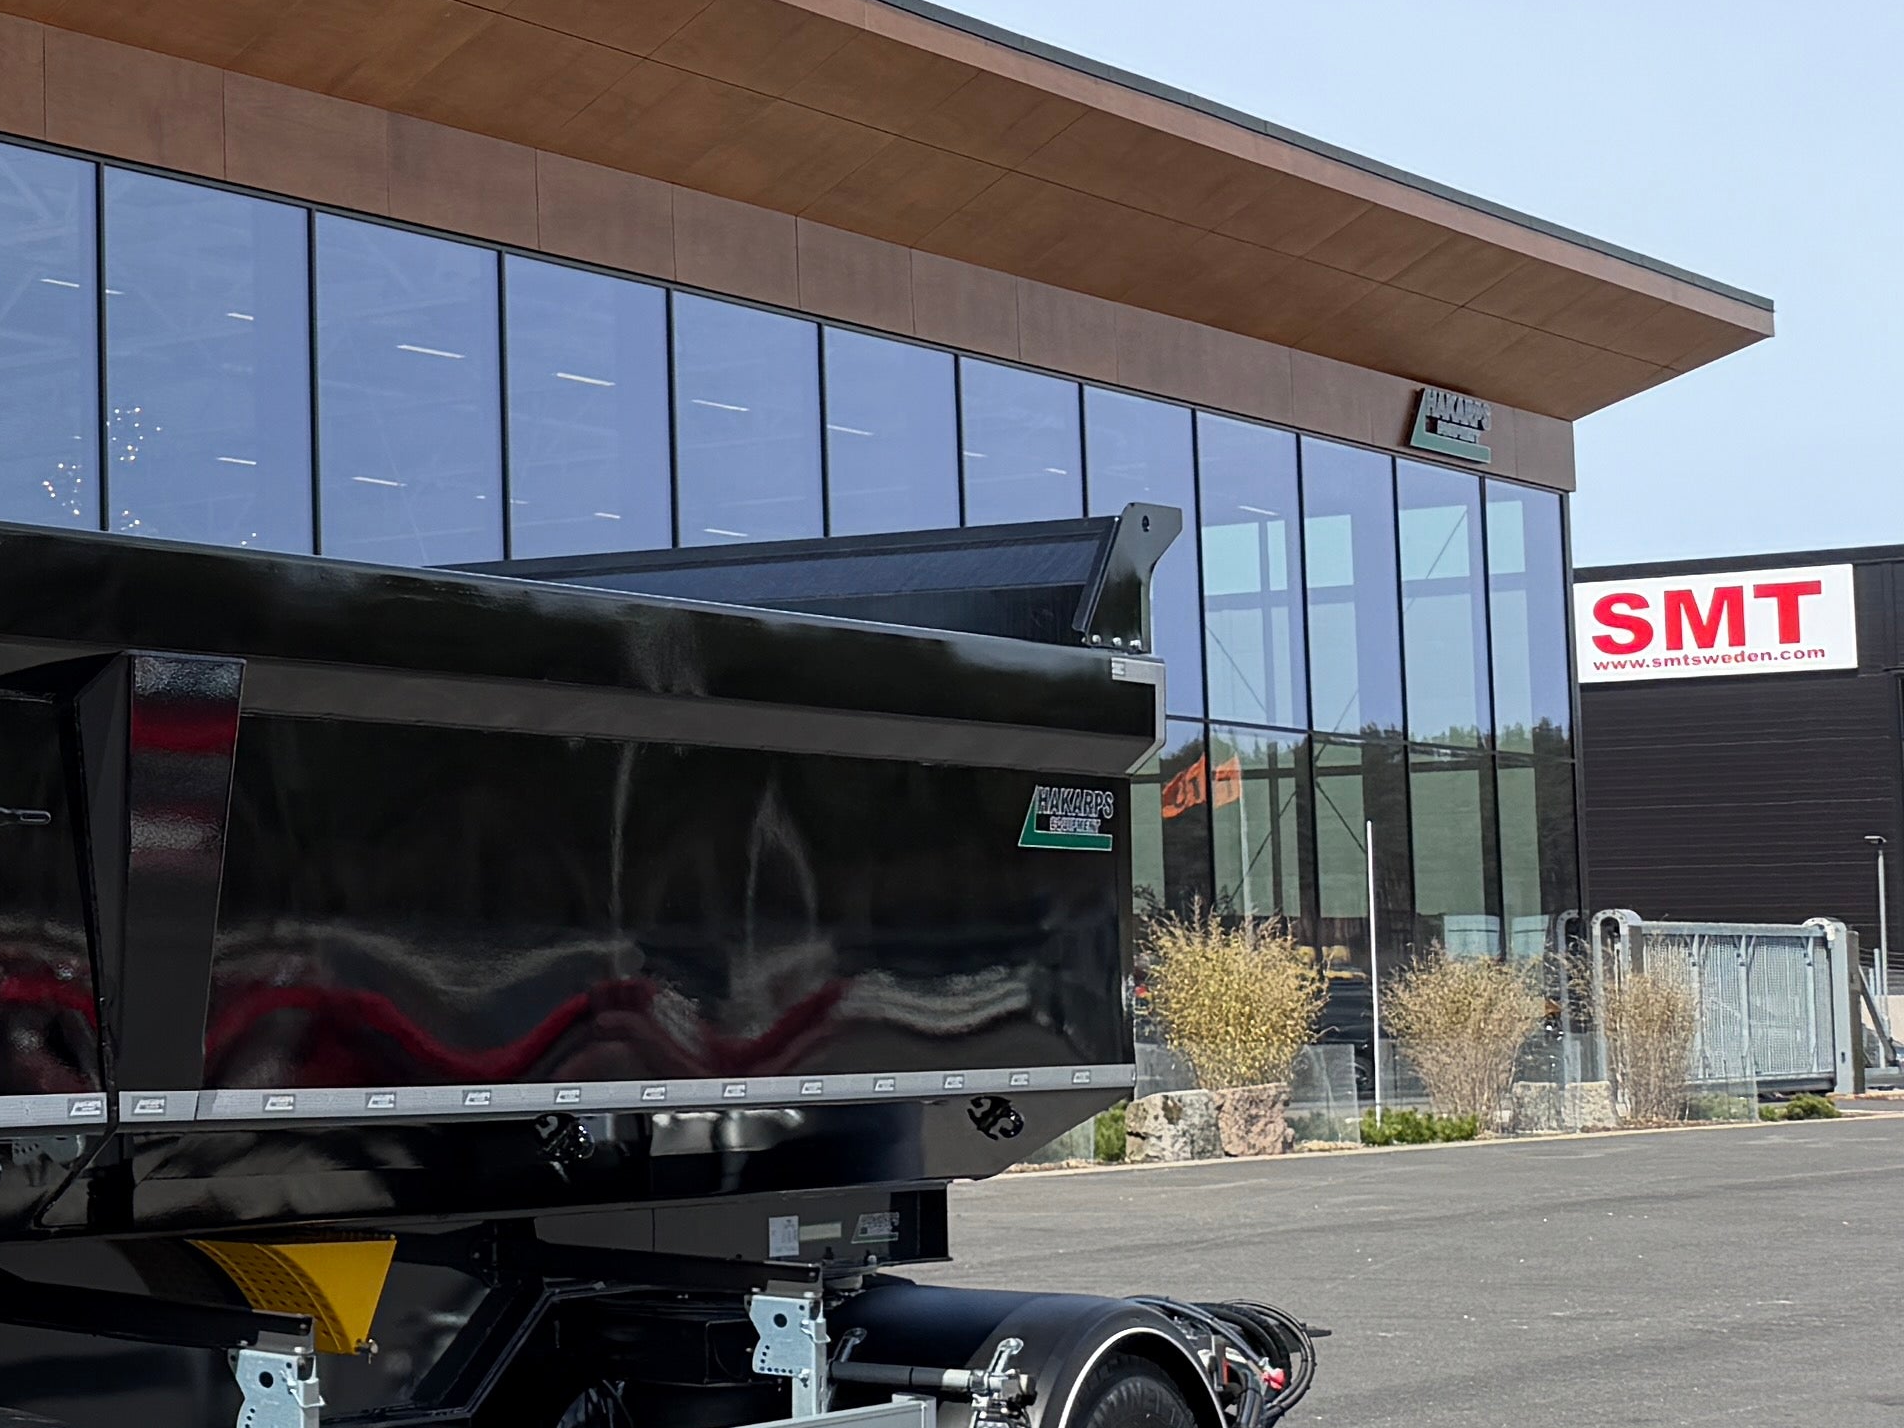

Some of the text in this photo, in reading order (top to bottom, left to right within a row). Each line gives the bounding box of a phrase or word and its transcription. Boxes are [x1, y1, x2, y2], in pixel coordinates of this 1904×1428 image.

[1592, 580, 1822, 655] SMT
[1593, 647, 1826, 671] www.smtsweden.com
[1037, 786, 1114, 819] HAKARPS
